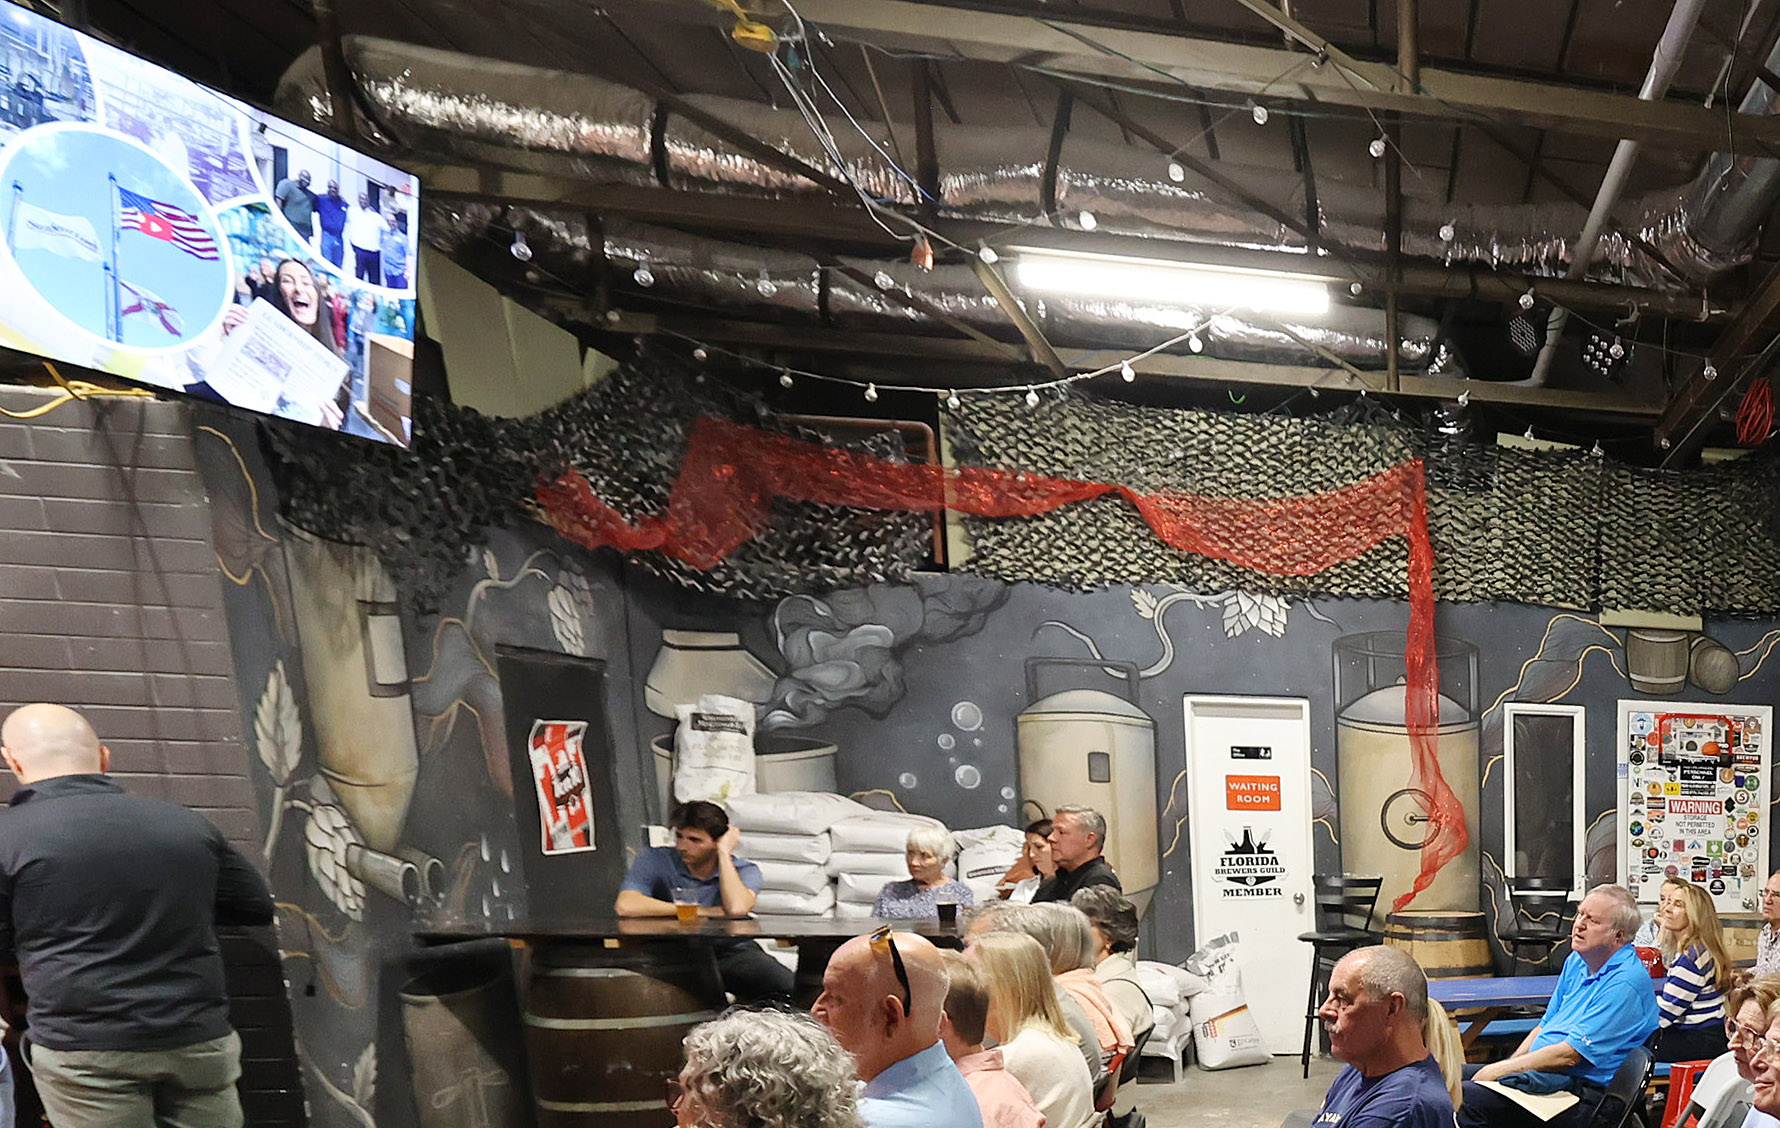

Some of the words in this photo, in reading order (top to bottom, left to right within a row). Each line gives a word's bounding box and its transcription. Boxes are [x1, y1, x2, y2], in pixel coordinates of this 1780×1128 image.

[1228, 783, 1278, 792] WAITING
[1236, 795, 1271, 804] ROOM
[1670, 801, 1720, 814] WARNING
[1220, 856, 1279, 867] FLORIDA
[1215, 867, 1257, 875] BREWERS
[1223, 887, 1282, 897] MEMBER
